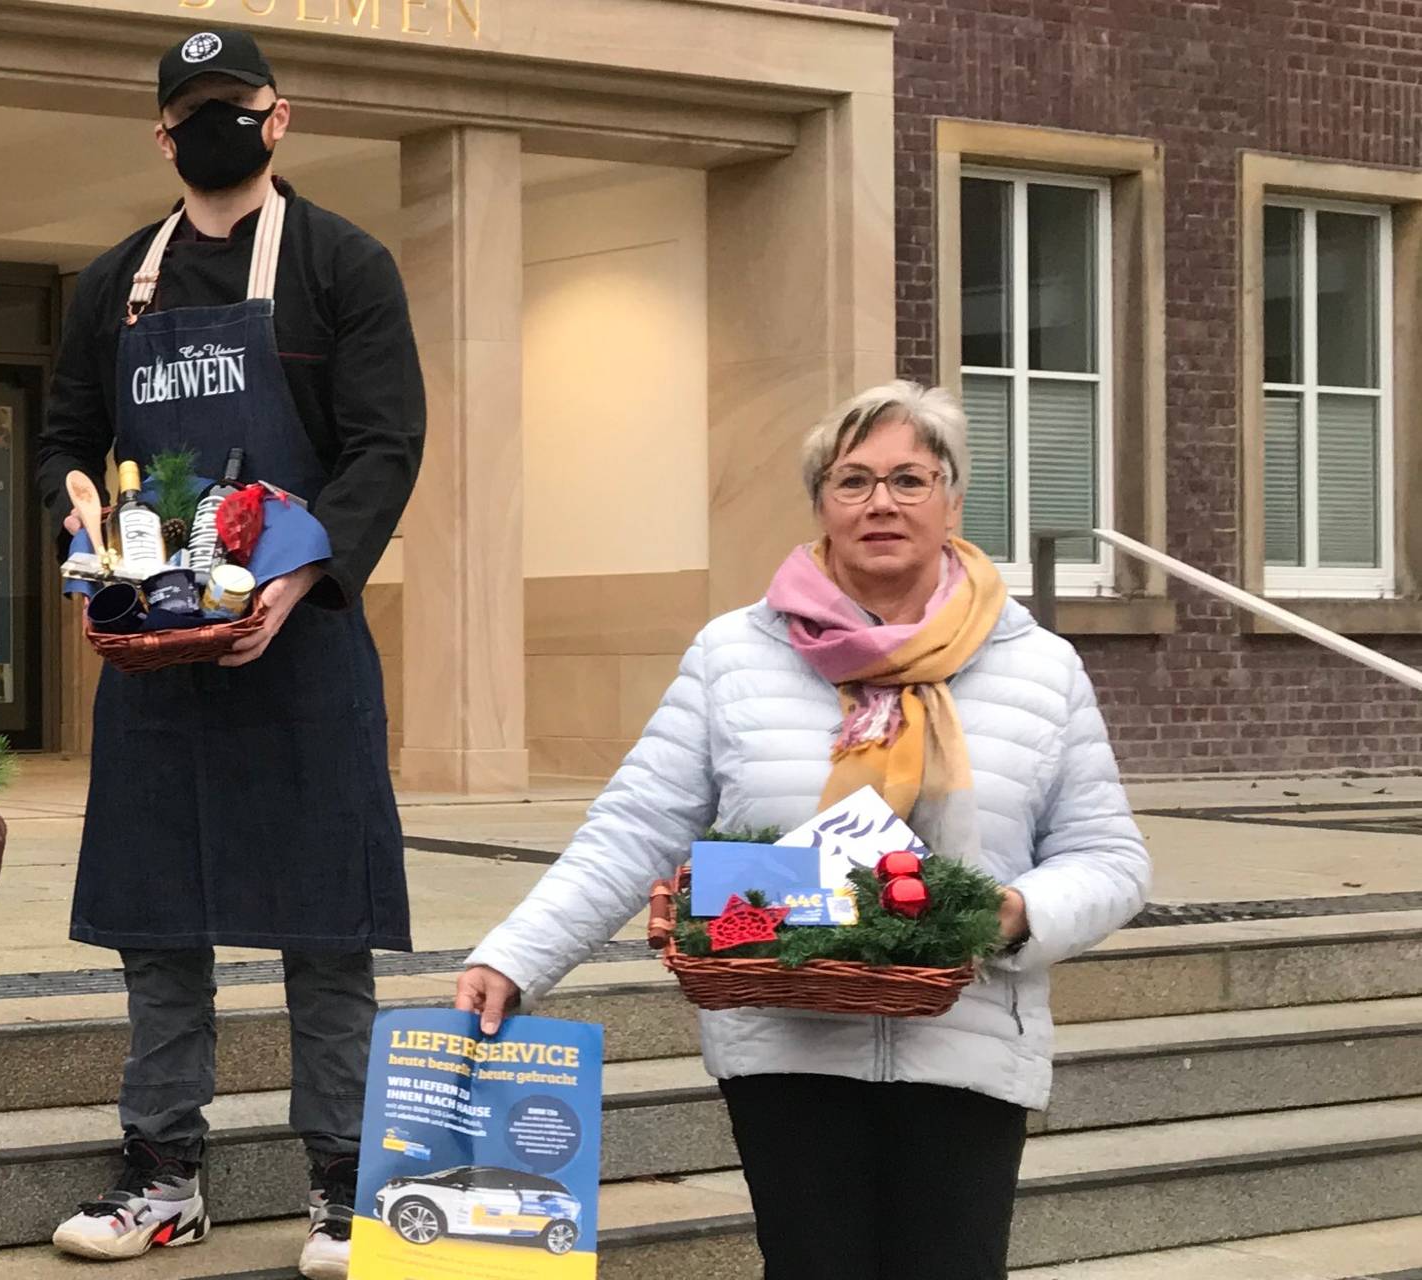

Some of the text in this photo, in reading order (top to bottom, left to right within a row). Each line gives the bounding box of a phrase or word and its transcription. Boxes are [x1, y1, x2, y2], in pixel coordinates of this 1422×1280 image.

[178, 0, 480, 40] MEN
[390, 1030, 579, 1067] LIEFERSERVICE
[387, 1076, 412, 1088] WIR
[413, 1079, 458, 1096] LIEFERN
[388, 1053, 426, 1068] heute
[478, 1069, 515, 1081] heute
[516, 1071, 578, 1086] gebracht
[386, 1089, 423, 1102] IHNEN
[424, 1094, 456, 1109] NACH
